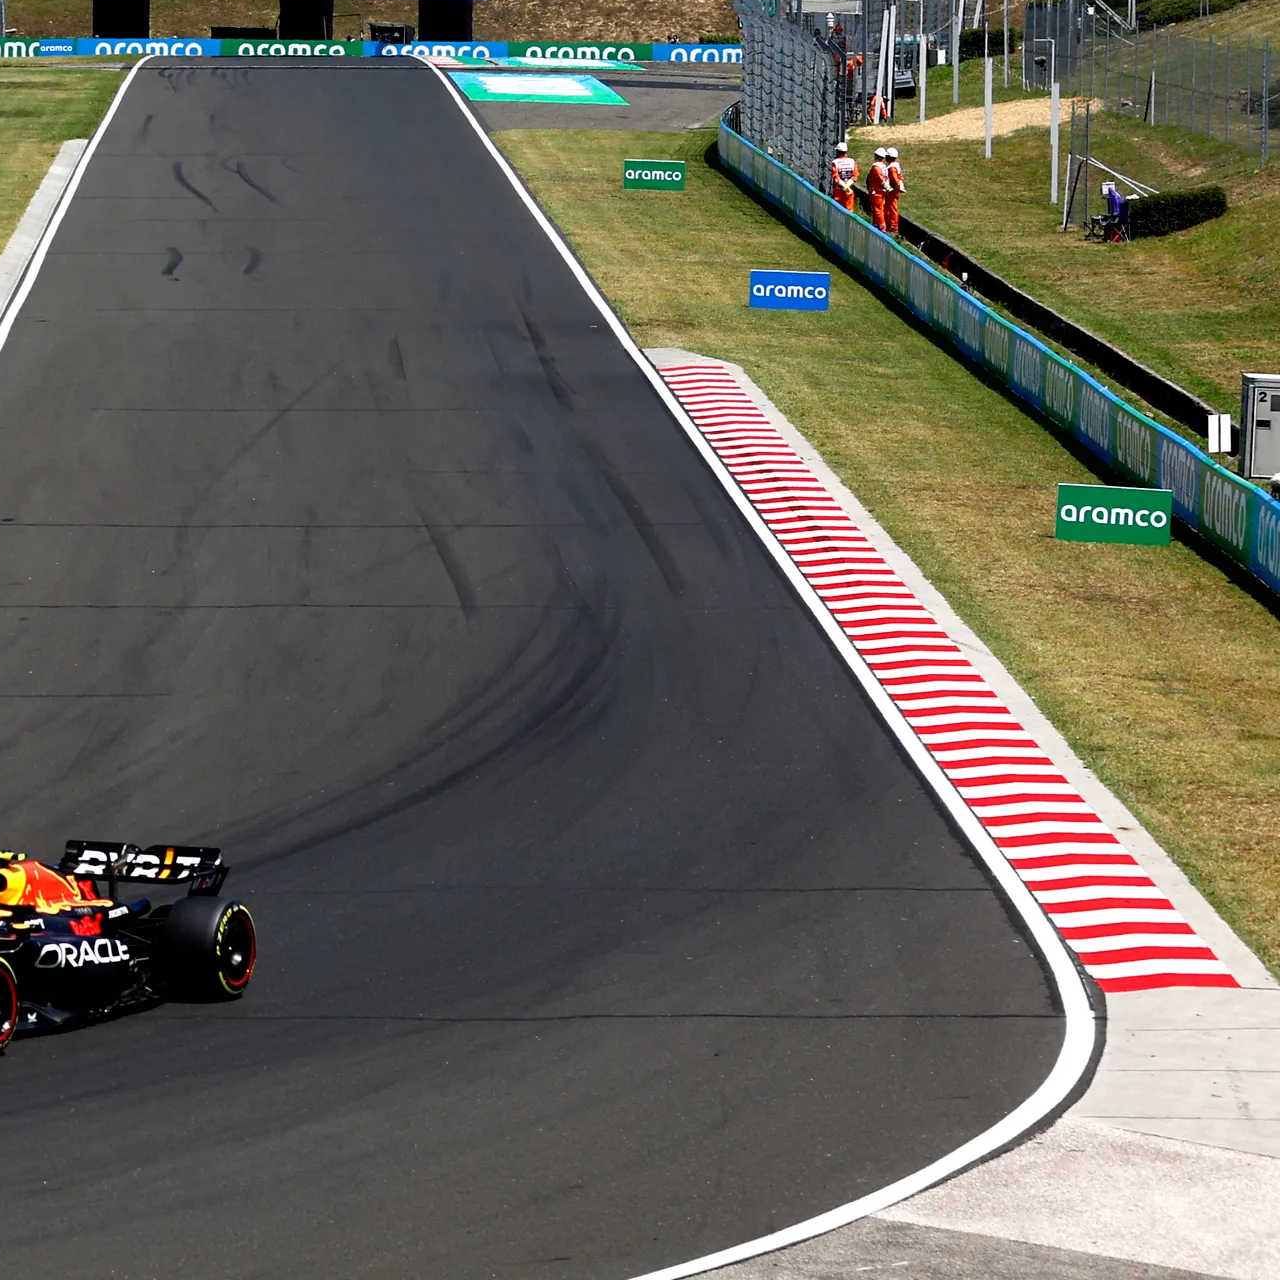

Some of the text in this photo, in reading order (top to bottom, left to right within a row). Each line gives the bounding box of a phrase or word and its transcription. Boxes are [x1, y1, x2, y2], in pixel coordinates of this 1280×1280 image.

[95, 41, 203, 56] aramco
[625, 168, 682, 181] aramco
[752, 284, 827, 299] aramco
[1258, 392, 1268, 402] 2
[1060, 503, 1167, 528] aramco
[1204, 471, 1247, 550] aramco
[1257, 505, 1280, 579] ara
[34, 938, 130, 969] ORACLE
